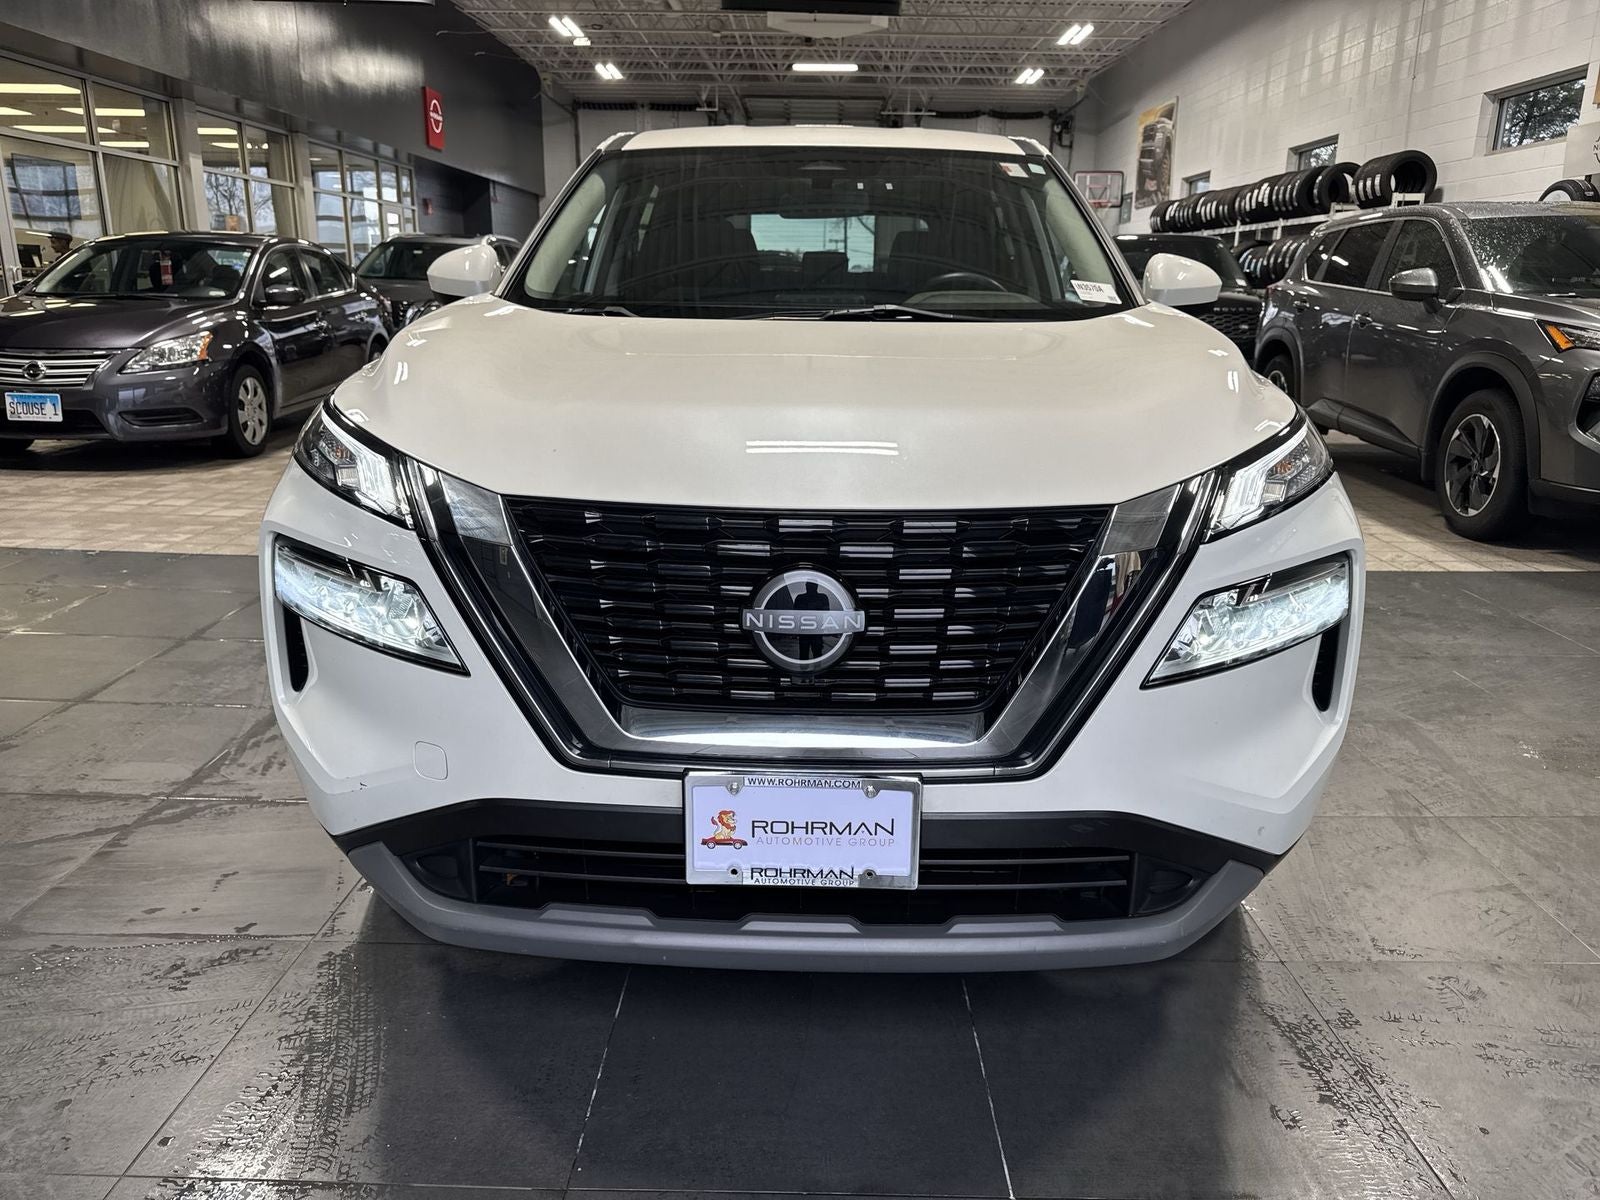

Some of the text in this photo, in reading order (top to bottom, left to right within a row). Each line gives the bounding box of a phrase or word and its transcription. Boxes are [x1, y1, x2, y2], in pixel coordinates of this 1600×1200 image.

[9, 401, 59, 416] SCOUSE 1
[746, 612, 861, 630] NISSAN
[748, 777, 861, 789] WWW.ROHRMAN.COM
[751, 818, 895, 838] ROHRMAN
[756, 836, 895, 847] AUTOMOTIVE GROUP
[750, 865, 854, 880] ROHRMAN
[754, 877, 855, 887] AUTOMOTIVE GROUP
